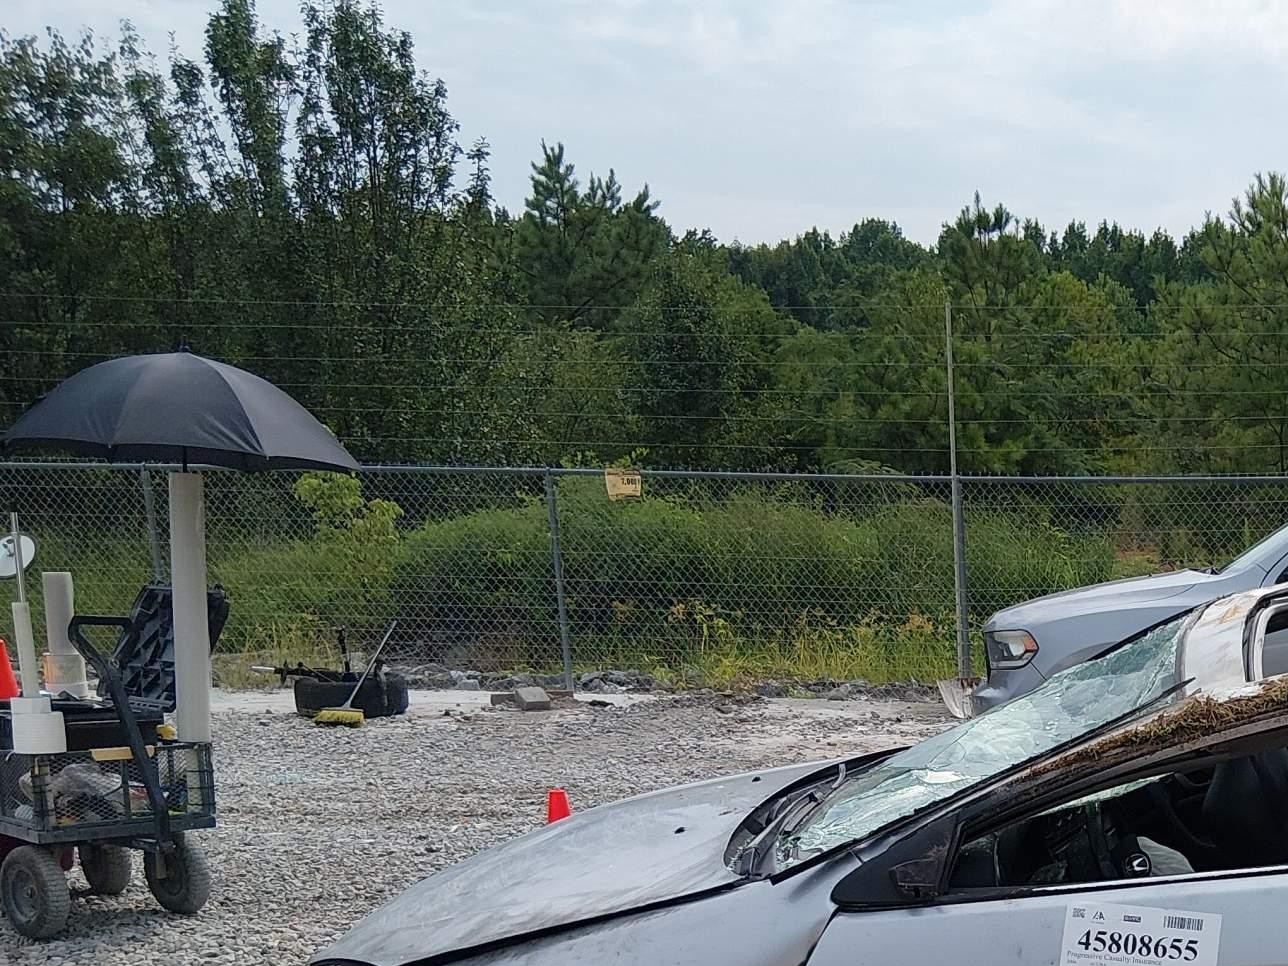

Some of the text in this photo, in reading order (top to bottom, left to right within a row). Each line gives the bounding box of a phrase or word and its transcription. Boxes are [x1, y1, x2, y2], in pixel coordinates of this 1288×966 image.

[1077, 928, 1199, 962] 45808655
[1067, 950, 1102, 961] Progressive
[1104, 953, 1131, 964] Casualty
[1132, 957, 1163, 966] Insurance
